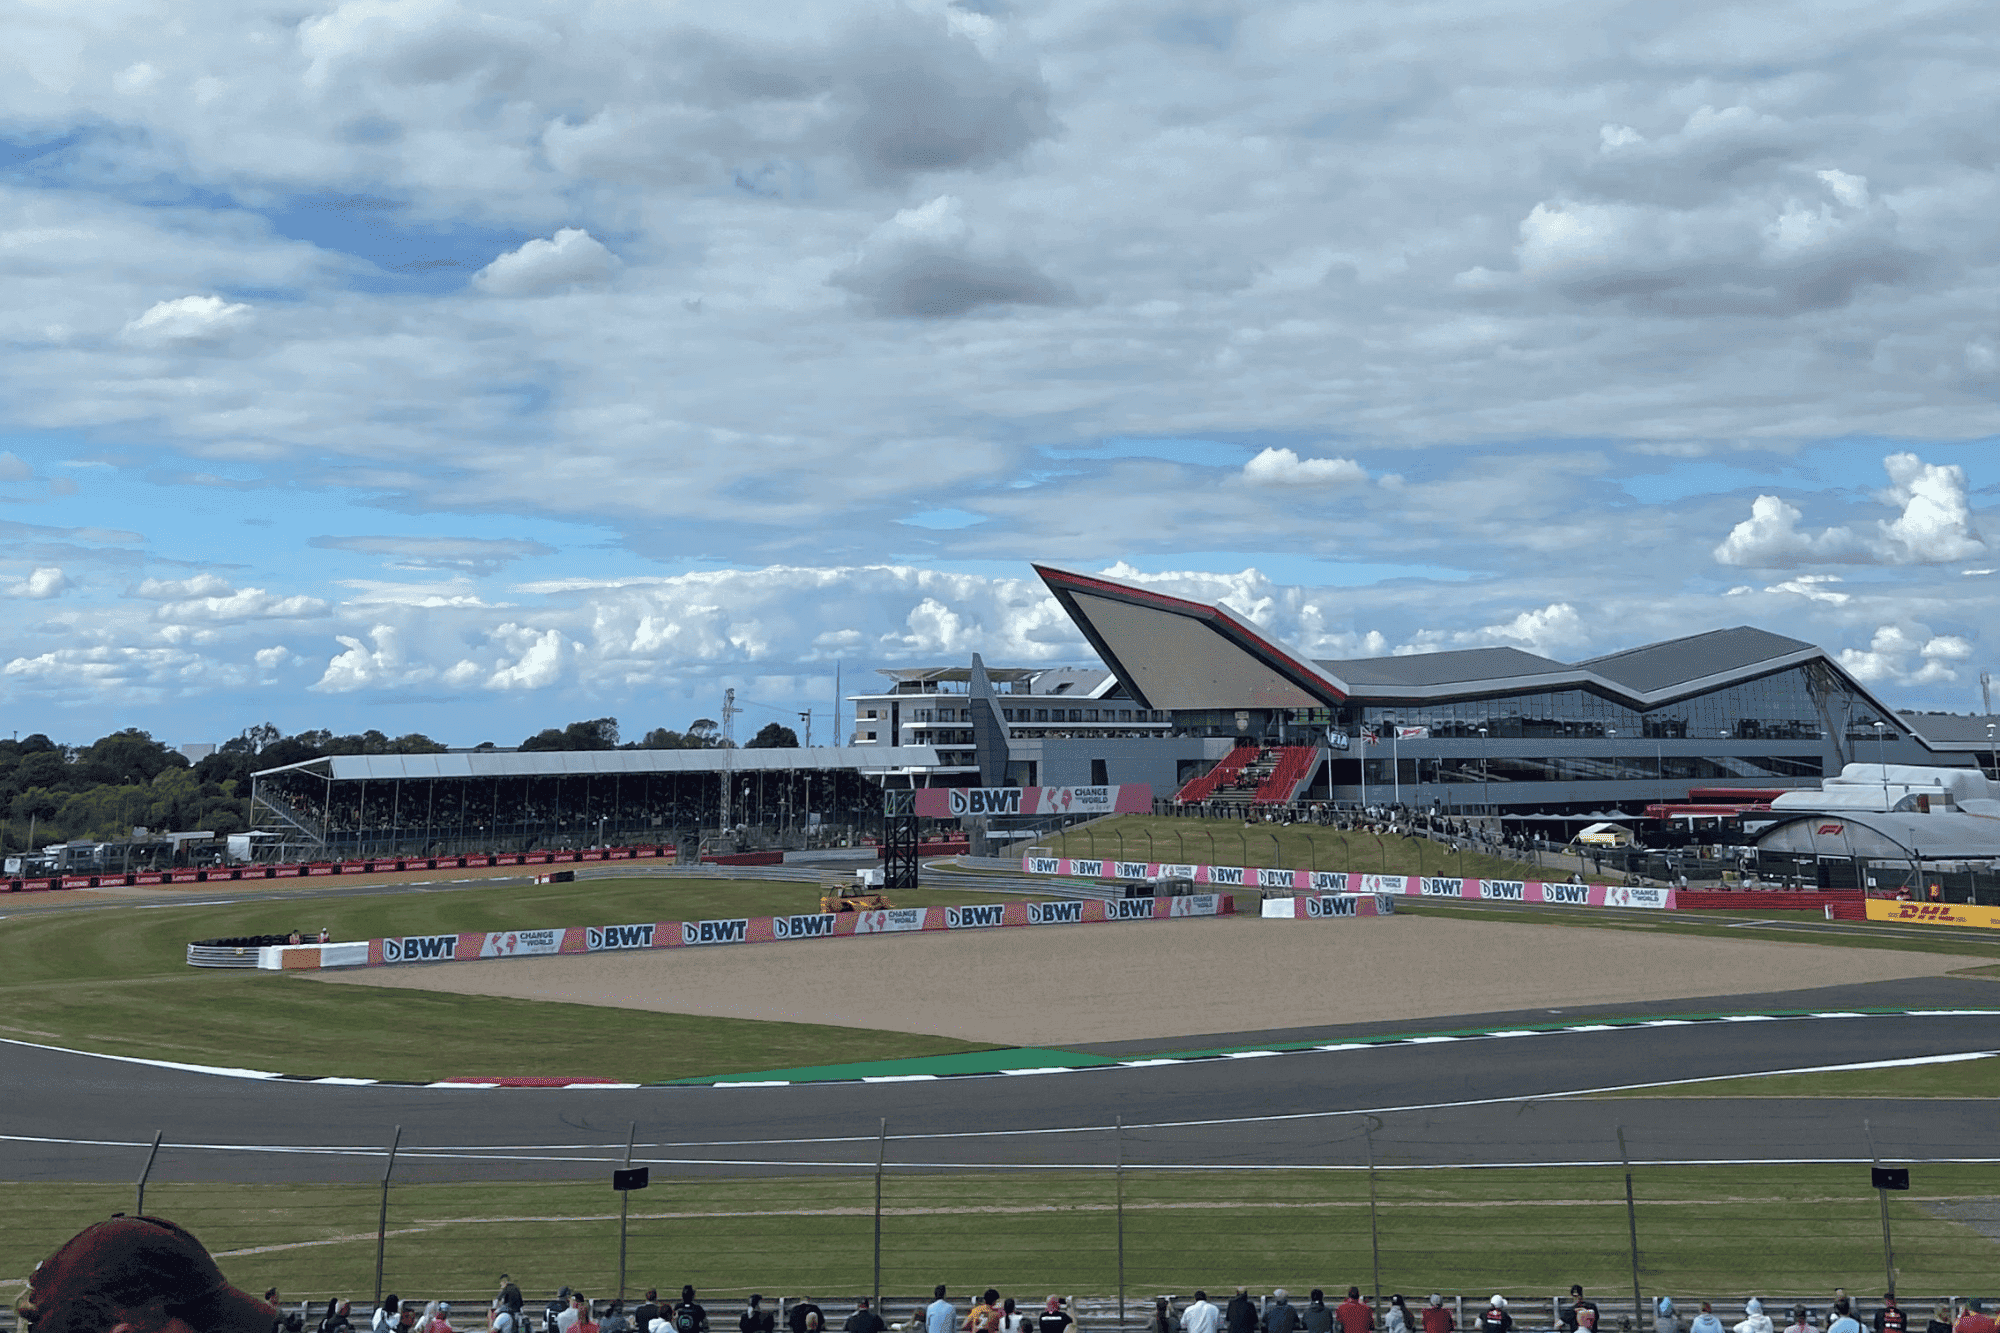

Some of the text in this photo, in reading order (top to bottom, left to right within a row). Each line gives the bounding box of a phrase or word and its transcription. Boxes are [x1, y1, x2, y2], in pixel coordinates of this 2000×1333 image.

[1331, 732, 1348, 746] FIA
[1074, 788, 1108, 796] CHANGE
[969, 789, 1021, 813] BWT
[1817, 825, 1843, 834] F1
[1037, 859, 1058, 872] BWT
[1079, 861, 1102, 875] BWT
[1123, 863, 1147, 877] BWT
[1217, 867, 1243, 882] BWT
[1320, 872, 1346, 889] BWT
[1432, 878, 1462, 895] BWT
[1492, 882, 1523, 898] BWT
[1555, 885, 1588, 902] BWT
[1042, 902, 1082, 922] BWT
[1120, 899, 1154, 918] BWT
[1322, 898, 1356, 915] BWT
[1898, 905, 1955, 921] DHL
[961, 906, 1003, 926] BWT
[700, 920, 746, 942] BWT
[790, 916, 834, 936] BWT
[520, 931, 554, 939] CHANGE
[527, 938, 554, 946] WORLD
[605, 926, 653, 948] BWT
[404, 936, 457, 959] BWT
